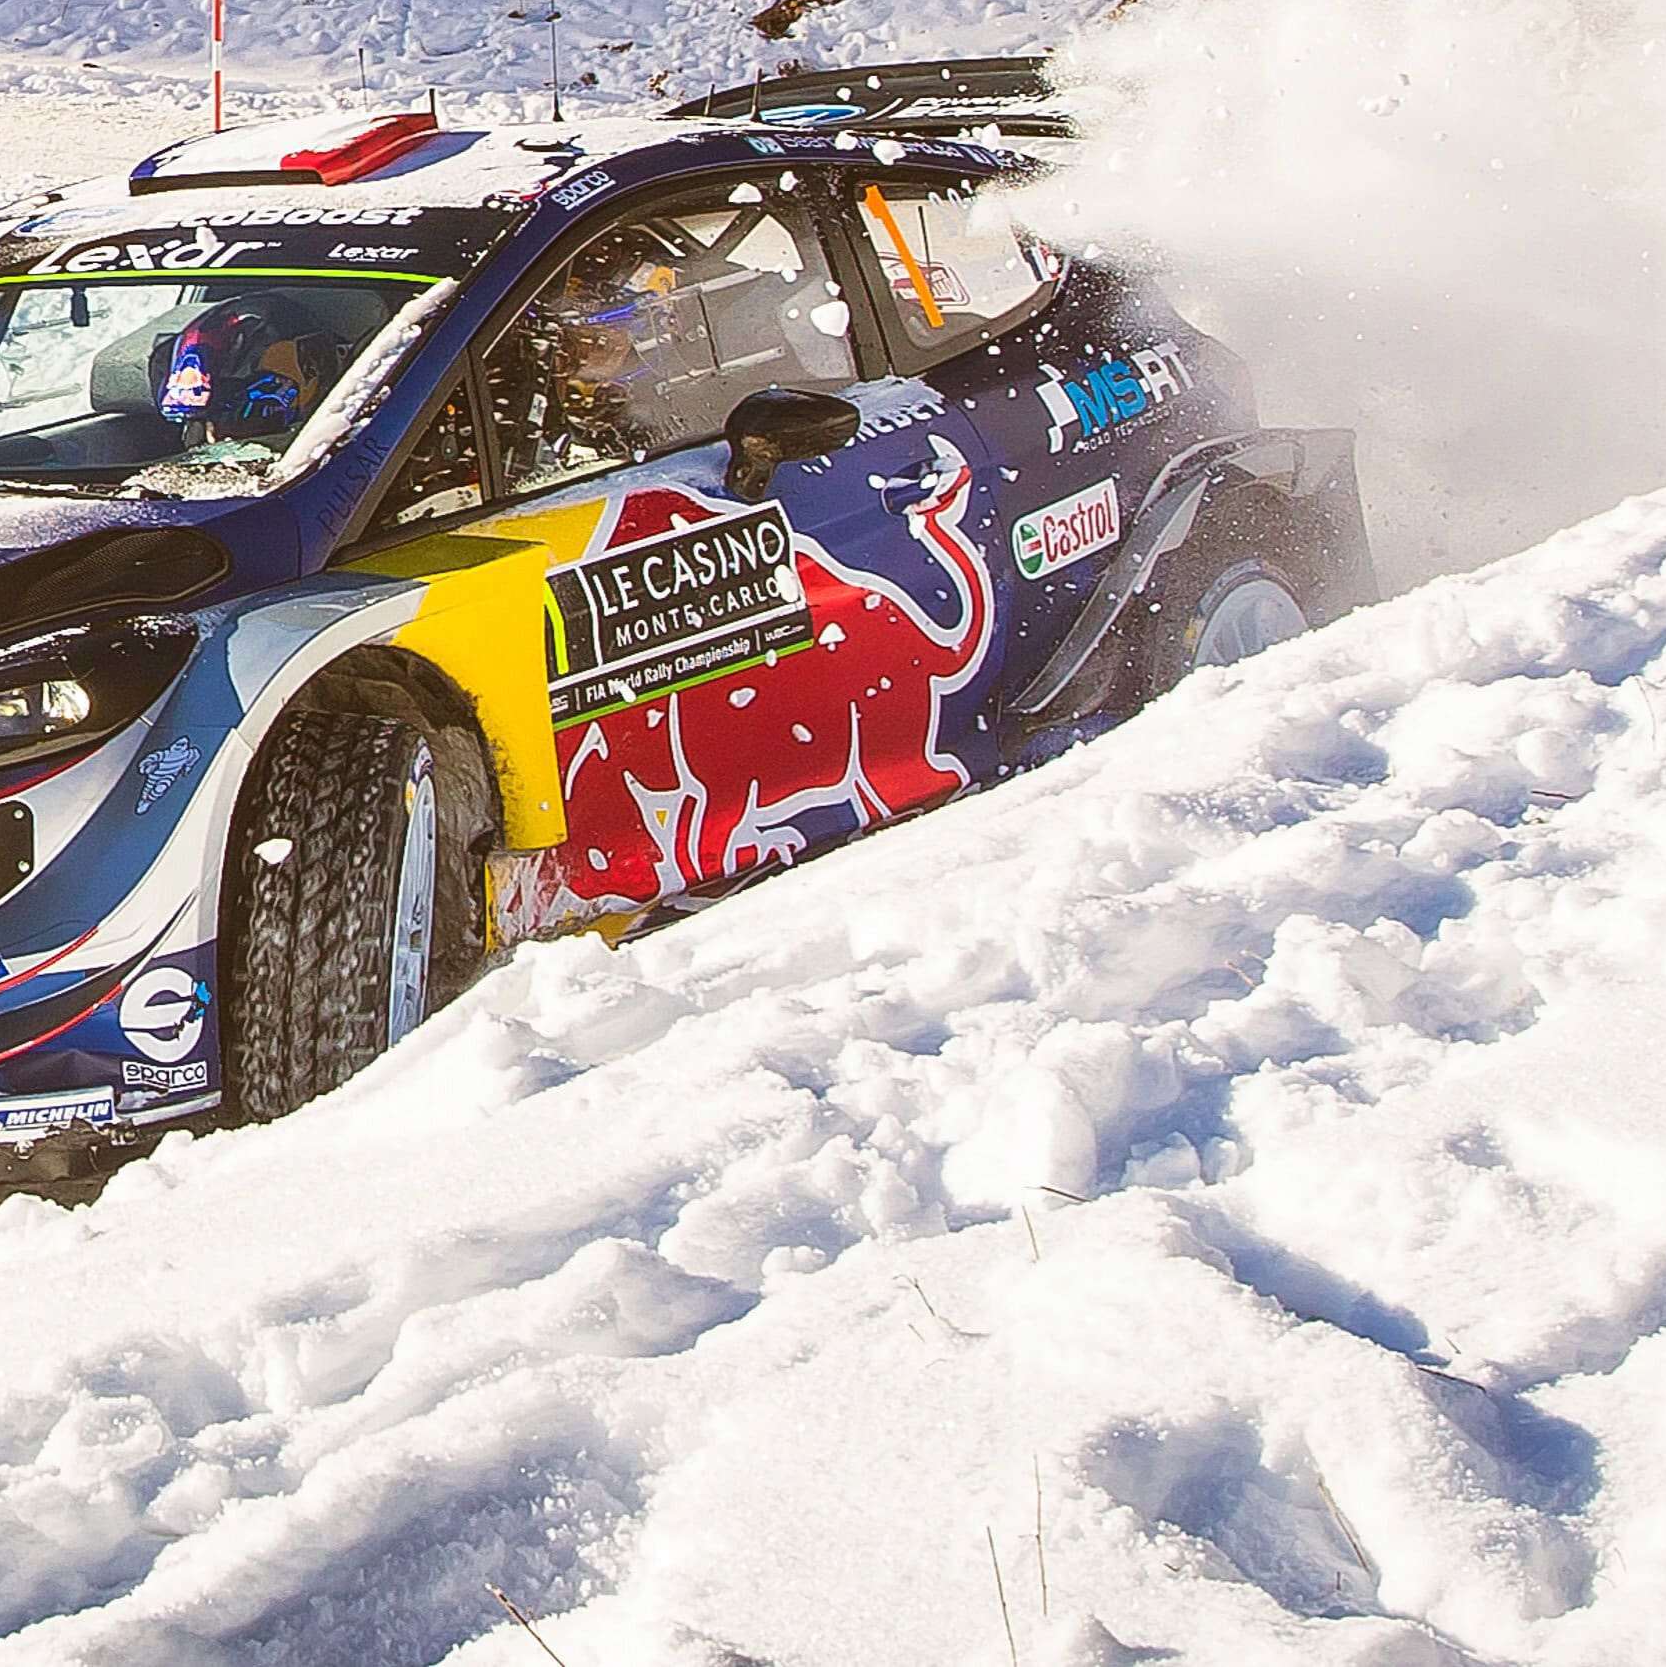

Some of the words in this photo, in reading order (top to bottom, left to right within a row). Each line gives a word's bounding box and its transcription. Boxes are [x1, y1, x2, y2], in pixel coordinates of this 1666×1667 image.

[551, 170, 612, 207] sparco
[27, 239, 265, 274] Lexar
[328, 243, 419, 261] Lexar
[1043, 490, 1116, 564] Castrol
[593, 565, 639, 617] LE
[643, 521, 785, 601] CASINO
[586, 683, 607, 703] FIA
[644, 663, 673, 685] Rally
[675, 637, 750, 674] Championship
[126, 1064, 205, 1087] sparco
[6, 1101, 110, 1126] MICHELIN
